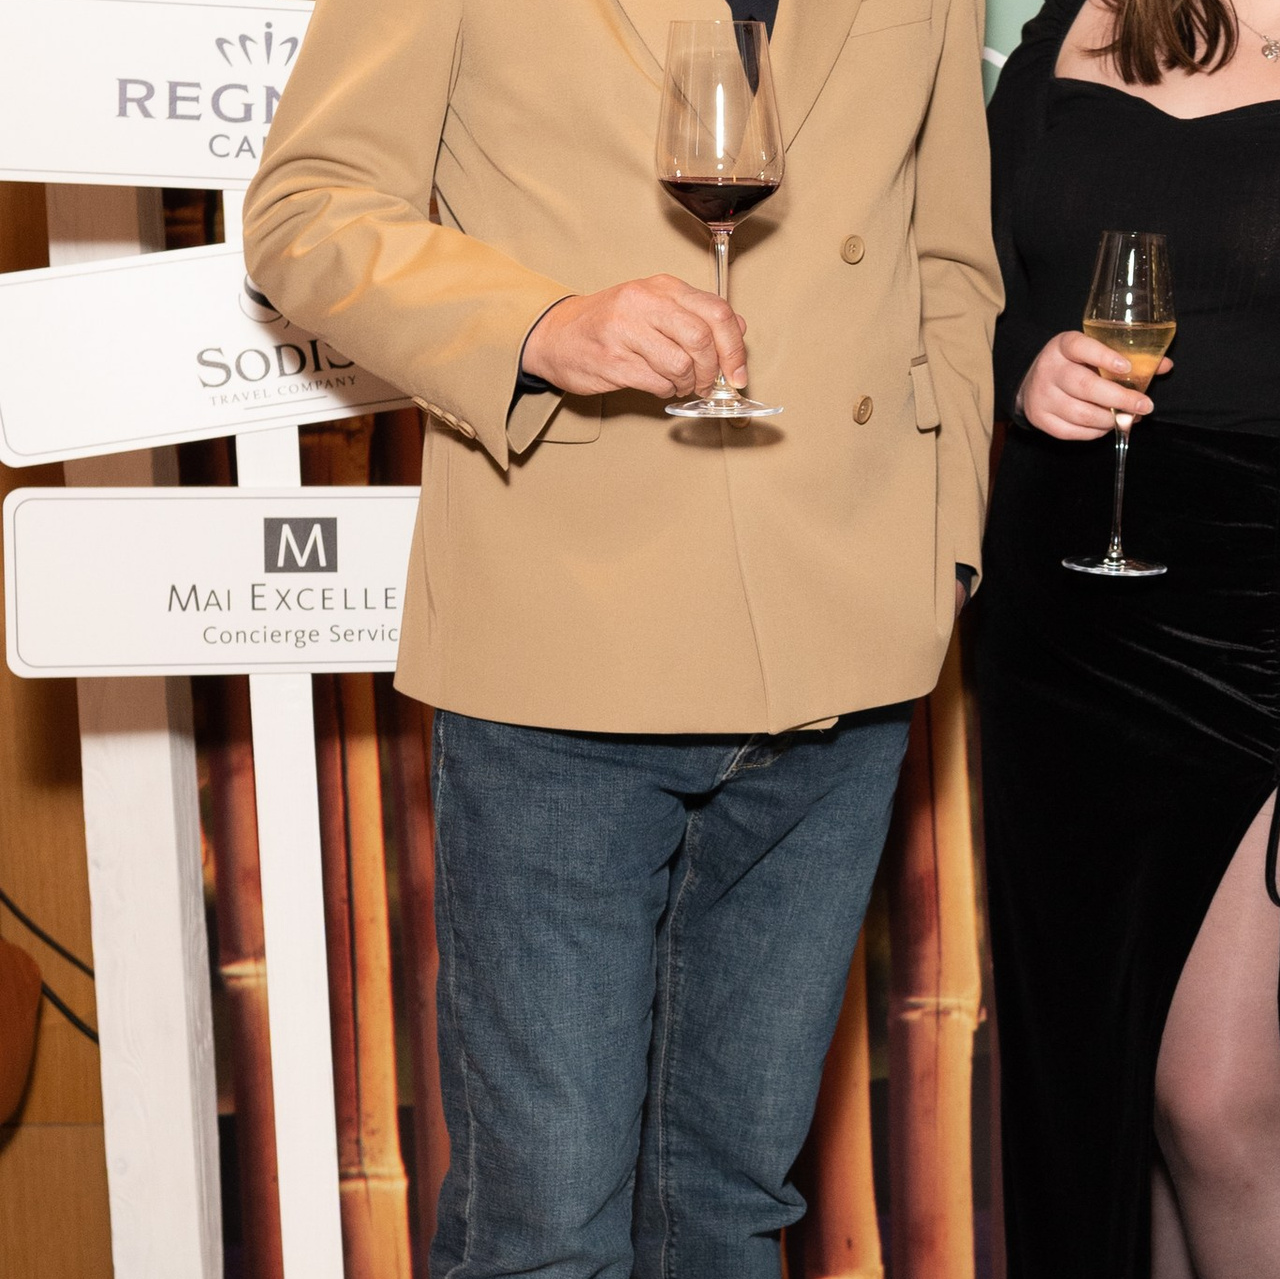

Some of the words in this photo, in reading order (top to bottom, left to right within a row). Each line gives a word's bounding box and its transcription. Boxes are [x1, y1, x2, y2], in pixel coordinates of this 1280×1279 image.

[208, 134, 267, 160] CA
[209, 389, 272, 407] TRAVEL
[277, 375, 357, 398] COMPANY
[276, 523, 327, 568] M
[202, 626, 320, 649] Concierge
[329, 624, 399, 643] Servic
